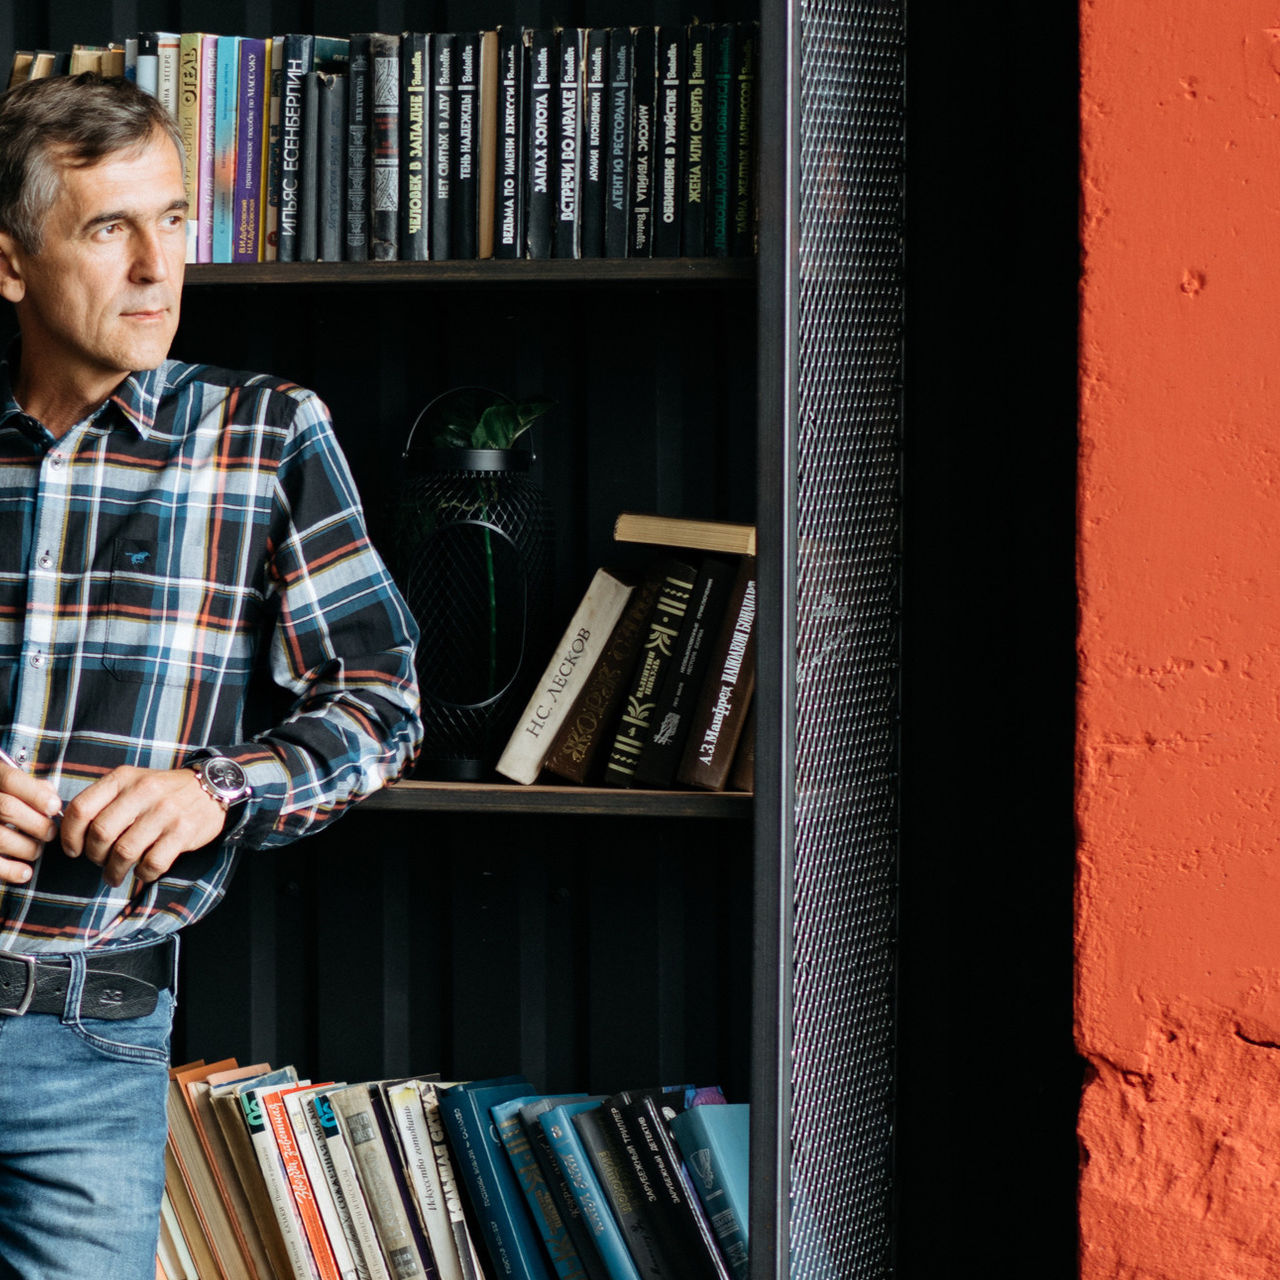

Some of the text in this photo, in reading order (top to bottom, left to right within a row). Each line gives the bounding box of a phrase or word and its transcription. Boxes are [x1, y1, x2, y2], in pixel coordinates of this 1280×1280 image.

[163, 54, 171, 83] ЗЕГЕРС
[182, 48, 198, 163] ХЕЙЛИ ОТЕЛЬ
[246, 52, 257, 139] пособие по МАССАЖУ
[439, 94, 452, 119] АДУ
[282, 59, 302, 236] ИЛЬЯС ЕСЕНБЕРЛИН
[409, 95, 424, 234] ЧЕЛОВЕК В ЗАПАДНЕ
[438, 133, 450, 176] СВЯТЫХ
[459, 94, 473, 179] ТЕНЬ НАДЕЖДЫ
[534, 93, 549, 193] ЗАПАХ ЗОЛОТА
[560, 90, 576, 221] ВСТРЕЧИ ВО МРАКЕ
[588, 92, 602, 181] МУМИЯ БЛОНДИНКИ
[613, 89, 626, 210] АГЕНТ ИЗ РЕСТОРАНА
[636, 105, 649, 202] МИССИС УБИЙЦА
[662, 89, 678, 223] ОБВИНЕНИЕ В УБИЙСТВЕ
[688, 87, 703, 202] ЖЕНА ИЛИ СМЕРТЬ
[437, 178, 449, 199] НЕТ
[502, 137, 516, 245] ВЕДЬМА ПО ИМЕНИ
[551, 626, 592, 704] ЛЕСКОВ
[636, 651, 656, 699] ВАЛЕНТИН
[645, 658, 661, 696] ПИКУЛЬ
[720, 624, 749, 685] НАПОЛЕОН
[628, 726, 636, 737] 4
[267, 1102, 313, 1203] Звезда заветная
[402, 1105, 438, 1212] Искусство готовить
[611, 1107, 657, 1202] ЗАРУБЕЖНЫЙ ТРИЛЛЕР
[637, 1116, 681, 1203] ЗАРУБЕЖНЫЙ ДЕТЕКТИВ
